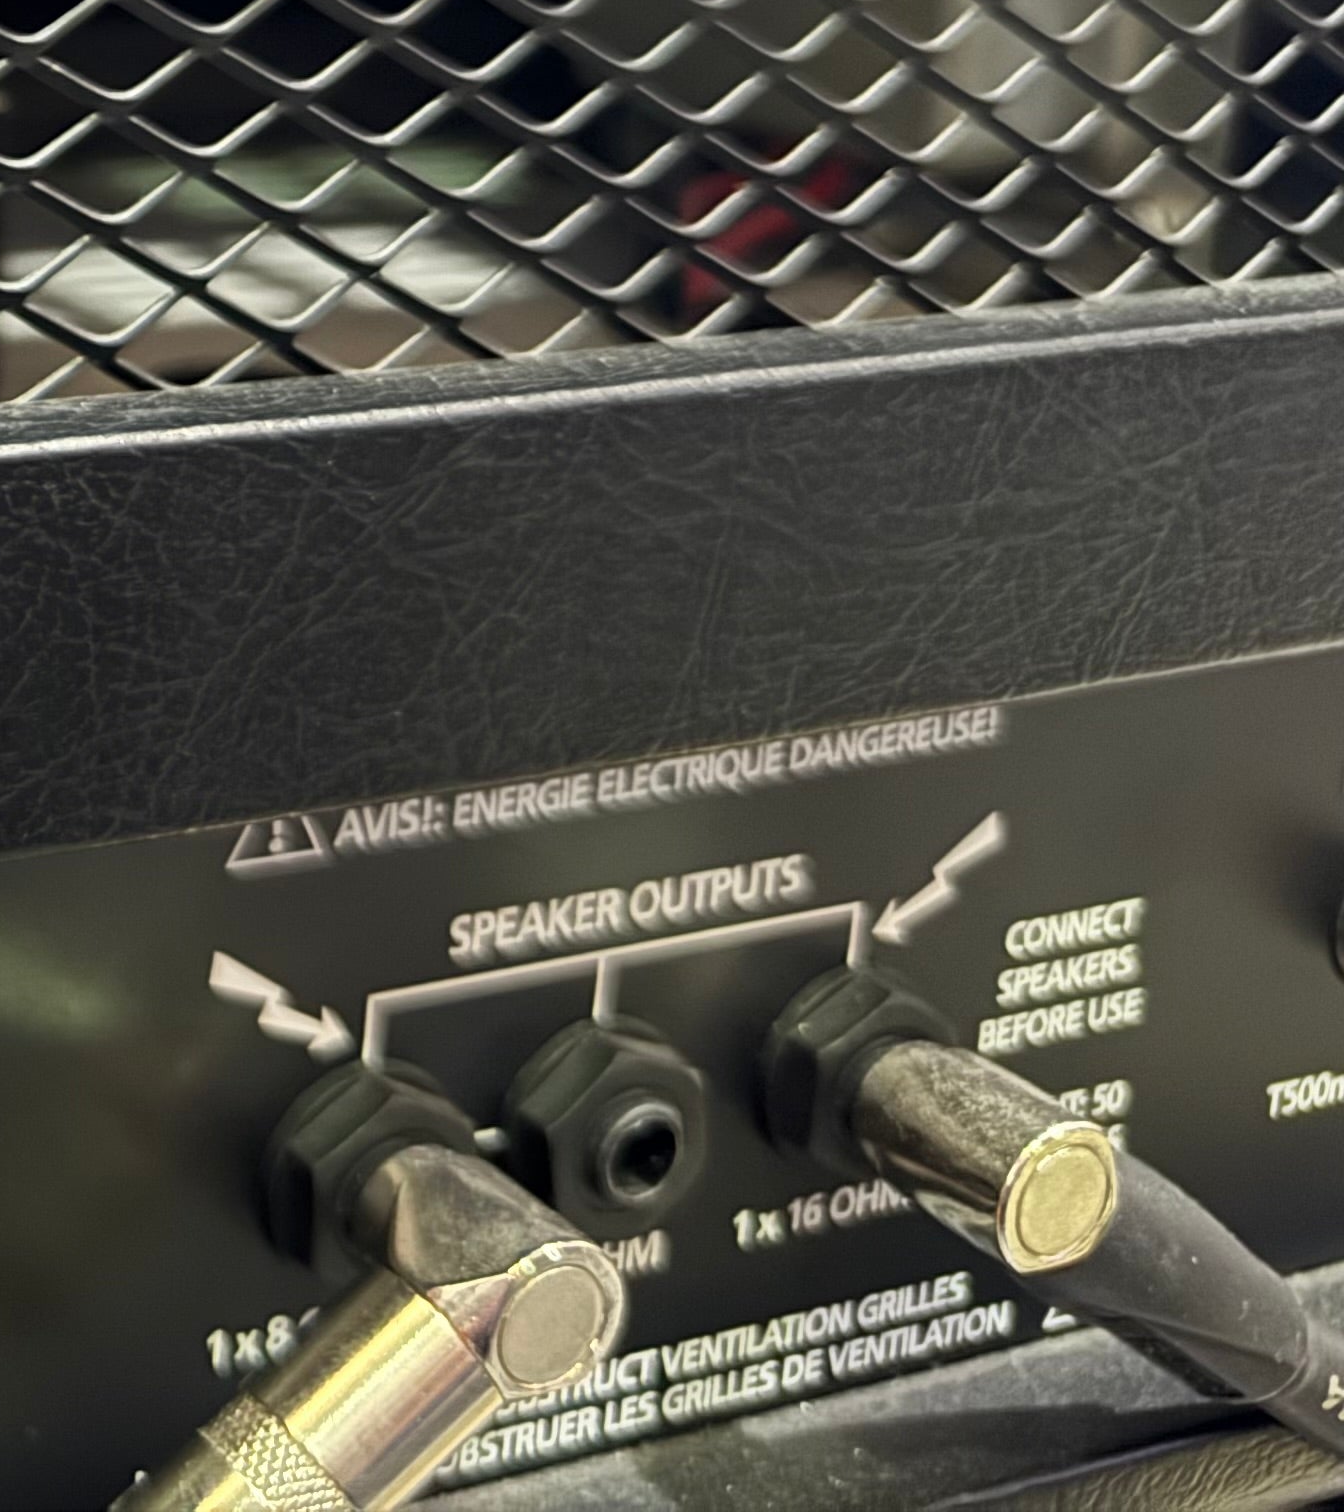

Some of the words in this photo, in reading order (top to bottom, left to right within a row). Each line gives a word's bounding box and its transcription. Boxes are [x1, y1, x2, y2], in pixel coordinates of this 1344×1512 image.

[452, 772, 591, 834] ENERGIE
[596, 744, 786, 813] ELECTRIQUE
[788, 706, 1000, 779] DANGEREUSE!
[448, 890, 622, 967] SPEAKER
[629, 853, 814, 931] OUTPUTS
[1005, 896, 1148, 960] CONNECT
[996, 943, 1143, 1008] SPEAKERS
[977, 999, 1088, 1056] BEFORE
[1087, 986, 1148, 1033] USE
[1091, 1079, 1131, 1118] 50
[604, 1390, 660, 1434] LES
[661, 1360, 781, 1424] GRILLES
[781, 1347, 828, 1387] DE
[828, 1299, 1015, 1379] VENTILATION
[662, 1298, 855, 1381] VENTILATION
[857, 1270, 973, 1329] GRILLES
